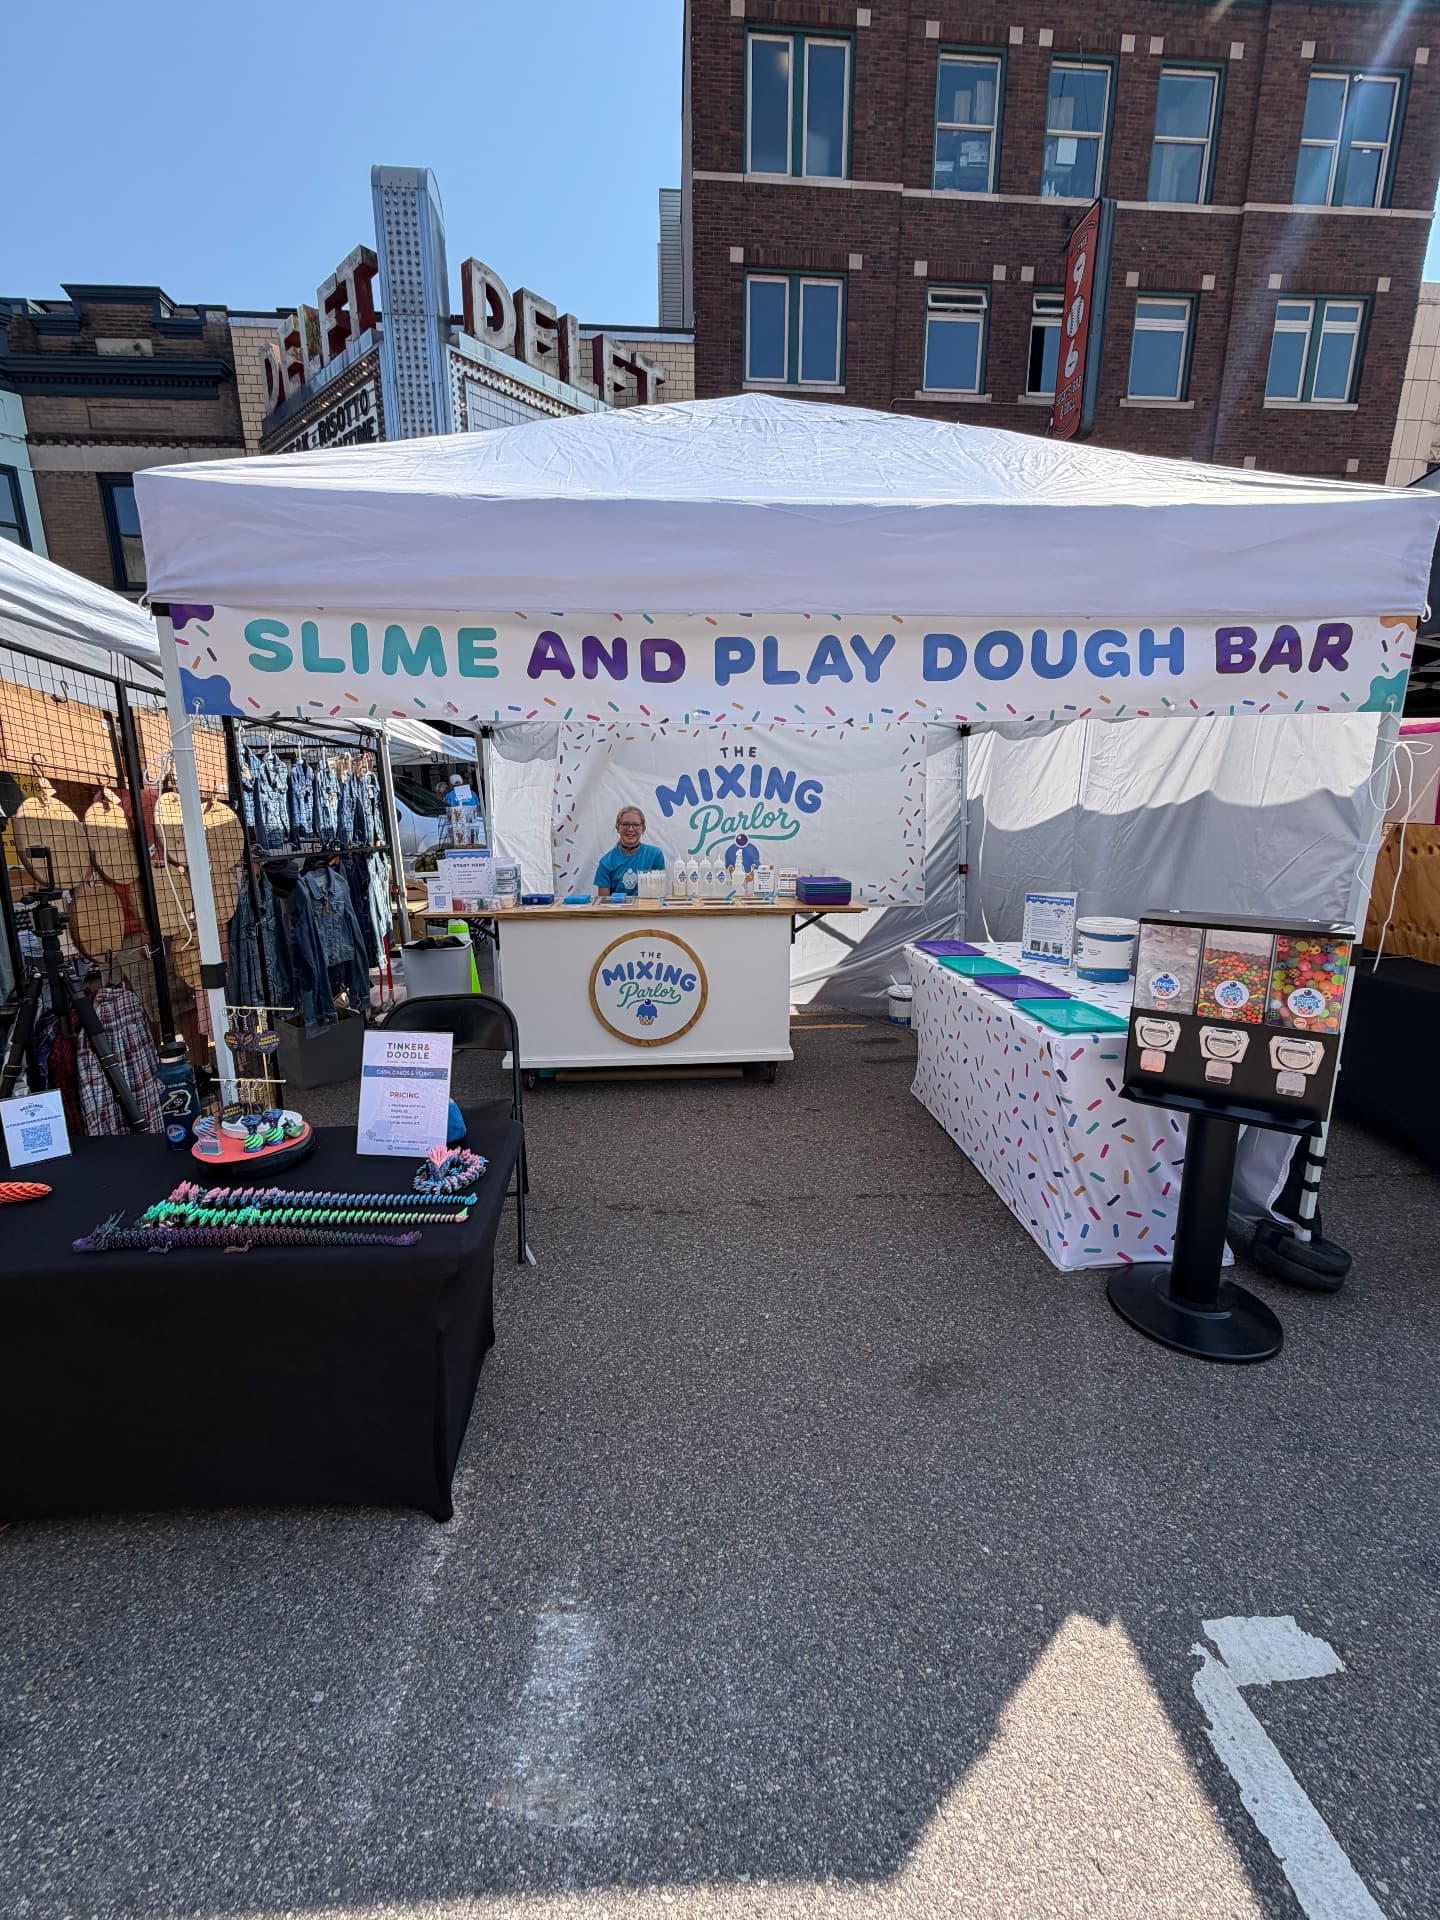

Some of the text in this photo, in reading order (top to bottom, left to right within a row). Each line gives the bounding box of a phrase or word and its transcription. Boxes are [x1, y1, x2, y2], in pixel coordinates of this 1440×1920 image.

[259, 244, 378, 412] DELFT
[461, 257, 666, 406] DELFT
[318, 388, 370, 446] RISOTTO
[244, 618, 1353, 686] SLIME AND PLAY DOUGH BAR
[720, 746, 757, 758] THE
[656, 763, 823, 817] MIXING
[688, 802, 800, 856] Parlor
[640, 951, 662, 959] THE
[602, 961, 697, 992] MIXING
[617, 982, 682, 1009] Parlor
[386, 1051, 430, 1060] DOODLE
[387, 1042, 430, 1051] TINKER&
[389, 1091, 420, 1099] PRICING
